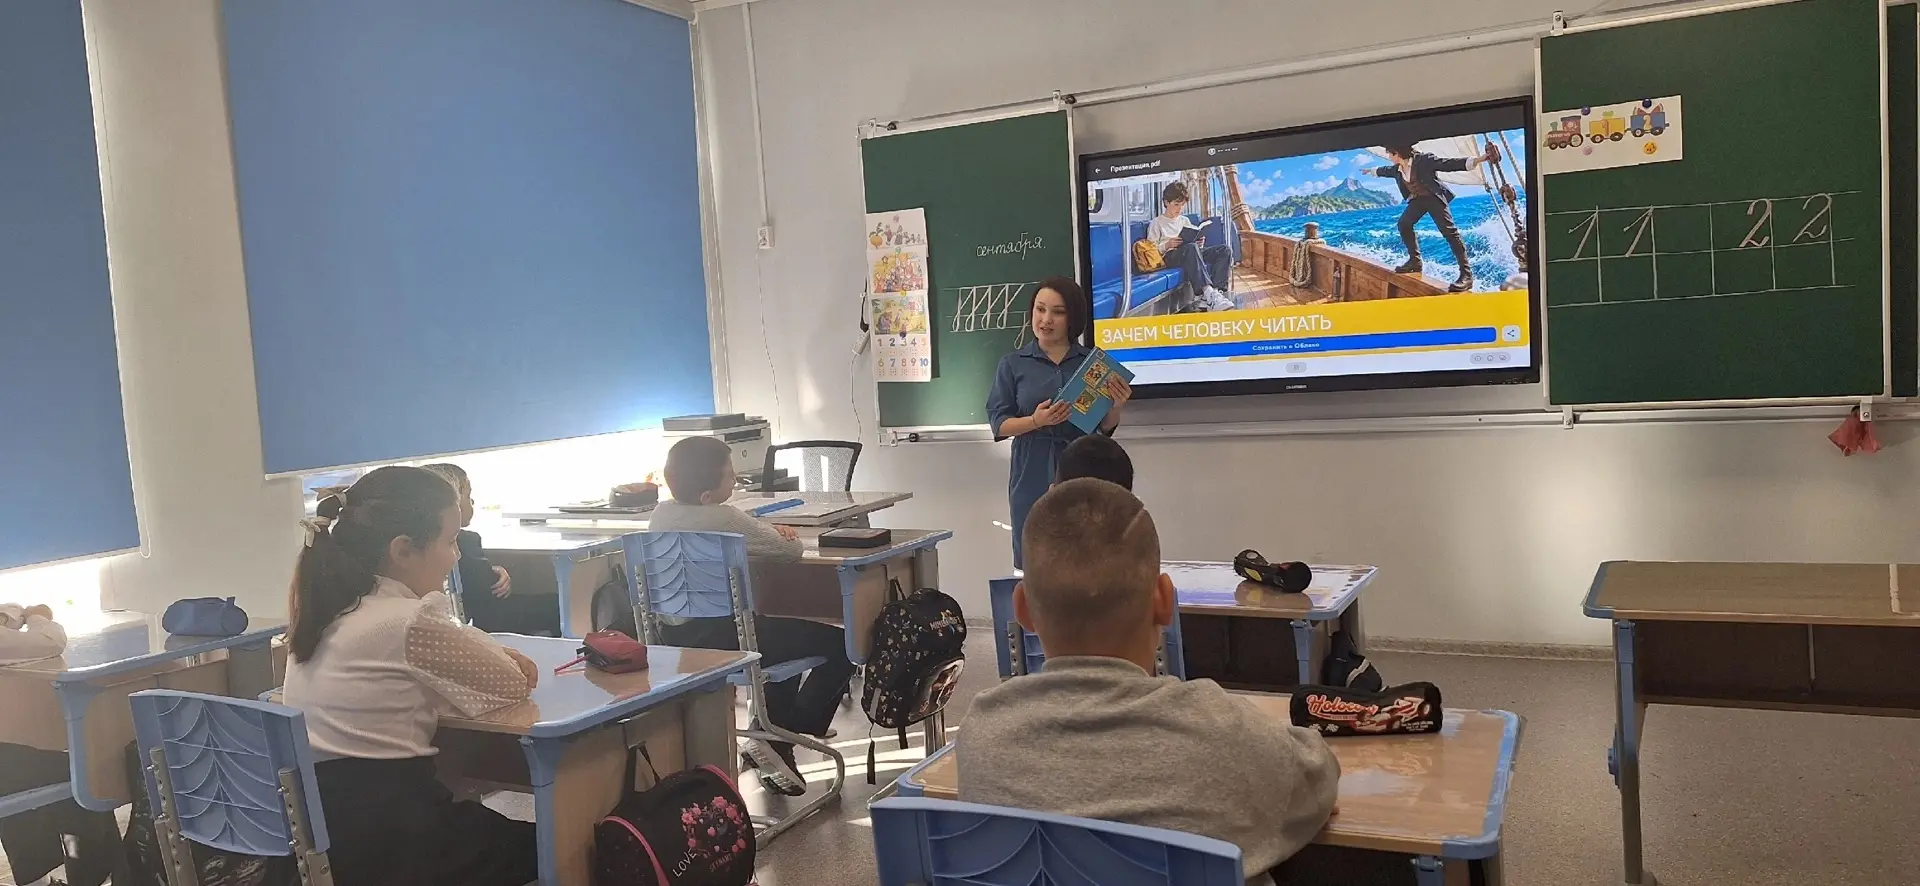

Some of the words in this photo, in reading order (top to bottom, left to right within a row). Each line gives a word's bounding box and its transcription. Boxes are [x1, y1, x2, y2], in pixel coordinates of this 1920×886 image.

[1739, 198, 1772, 248] 2
[1792, 193, 1832, 243] 2
[877, 338, 882, 347] 1
[889, 338, 896, 346] 2
[910, 337, 917, 346] 4
[1102, 326, 1158, 343] ЗАЧЕМ
[1162, 318, 1256, 340] ЧЕЛОВЕКУ
[1260, 314, 1332, 334] ЧИТАТЬ
[878, 359, 884, 367] 6
[890, 358, 896, 367] 7
[901, 358, 907, 367] 8
[911, 358, 917, 367] 9
[920, 358, 929, 367] 10
[672, 848, 697, 878] LOVE
